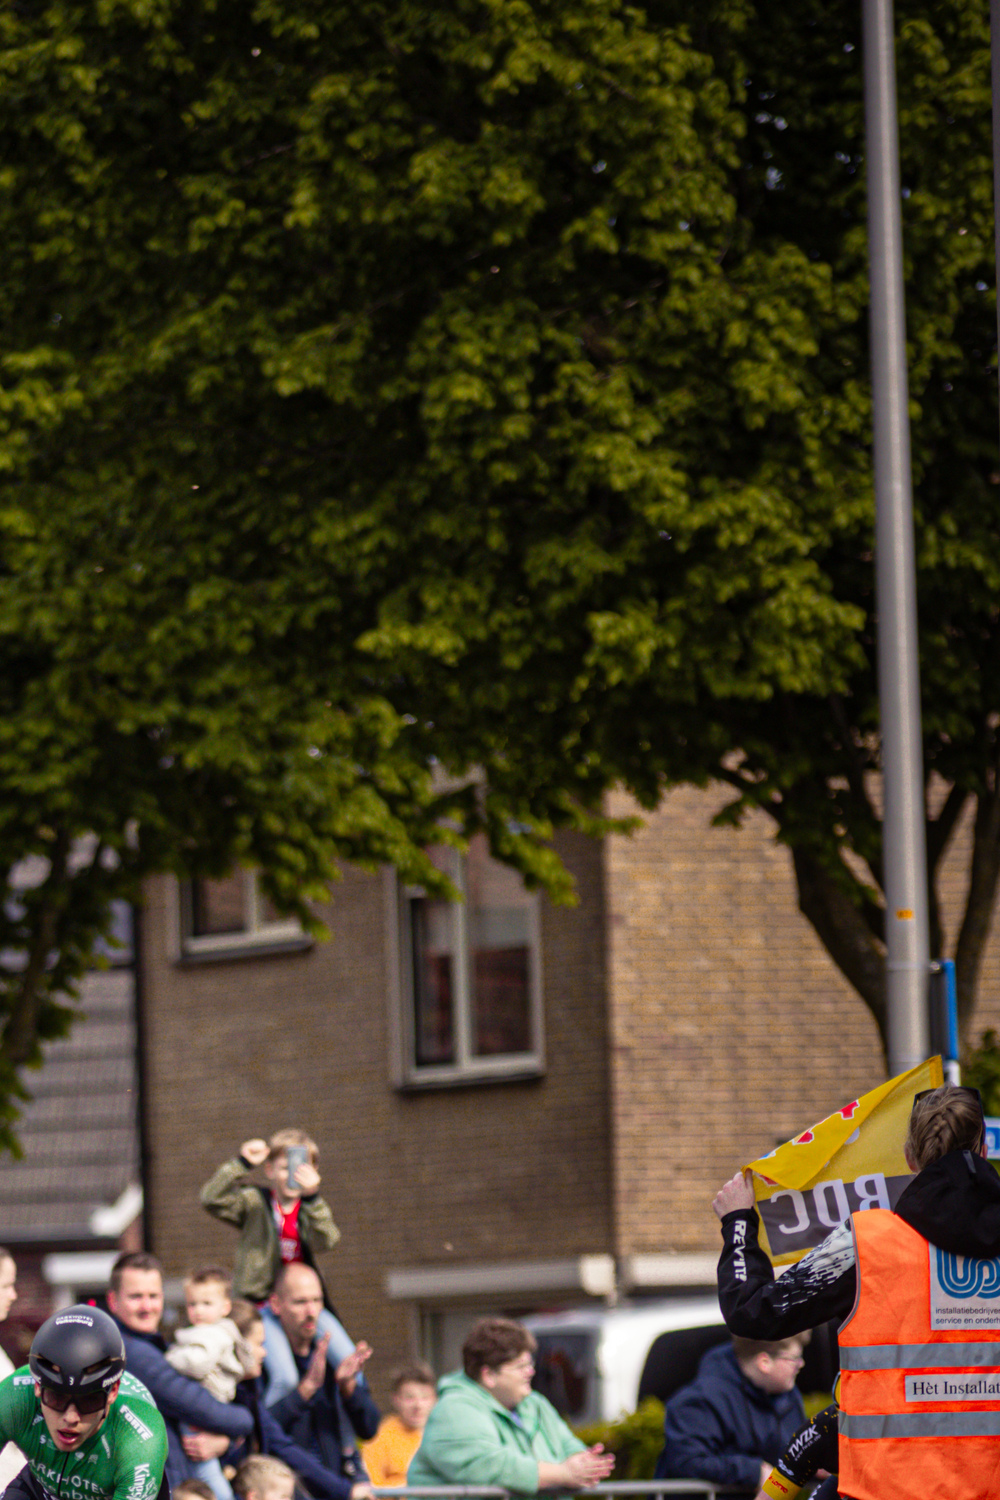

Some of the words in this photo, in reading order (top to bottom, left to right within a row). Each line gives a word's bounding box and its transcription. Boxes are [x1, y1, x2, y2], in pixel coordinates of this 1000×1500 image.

[935, 1317, 962, 1325] service
[963, 1317, 974, 1325] en
[912, 1381, 939, 1396] Hèt
[119, 1404, 154, 1441] FORTE
[28, 1458, 110, 1497] ARKHOTEL
